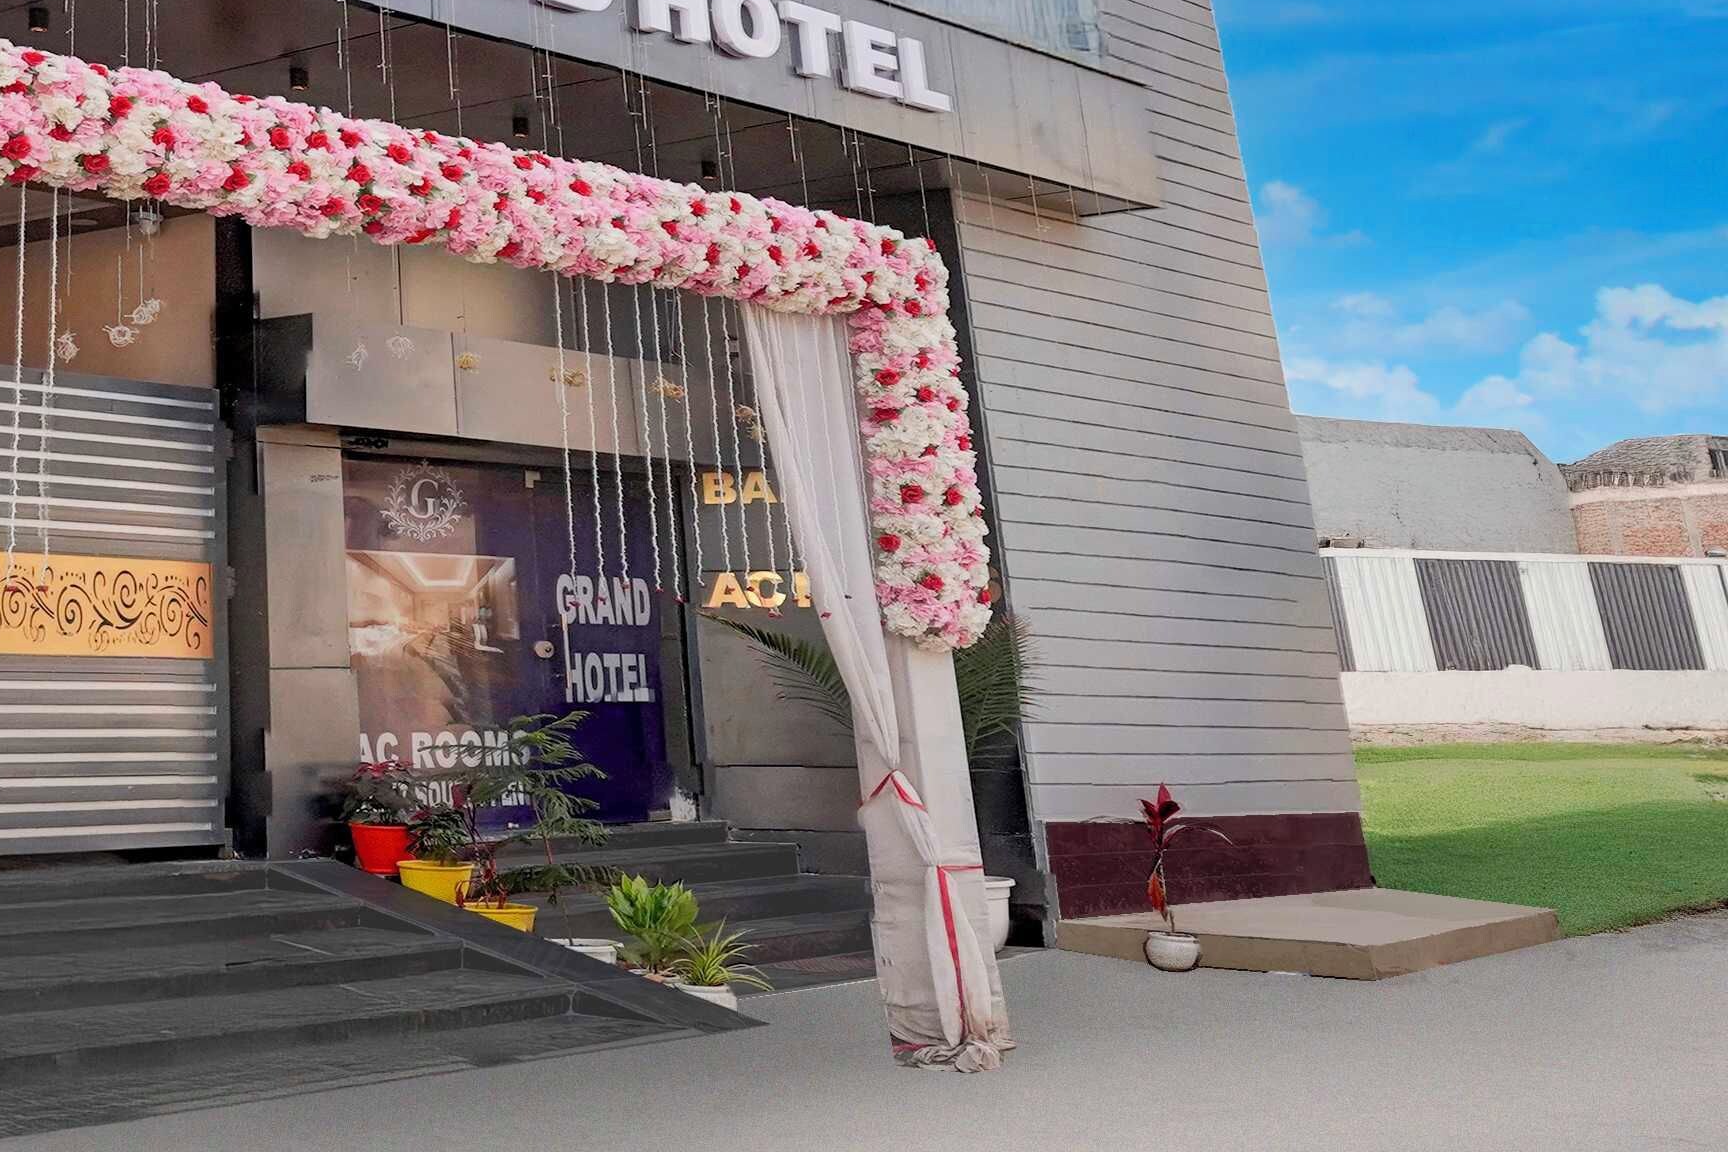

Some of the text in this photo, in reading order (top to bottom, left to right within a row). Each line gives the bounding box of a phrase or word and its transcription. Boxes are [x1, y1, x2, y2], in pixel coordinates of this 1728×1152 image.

[403, 478, 439, 519] G
[702, 471, 784, 504] BA
[556, 573, 651, 626] GRAND
[565, 652, 655, 703] HOTEL
[359, 729, 530, 769] AC ROOMS
